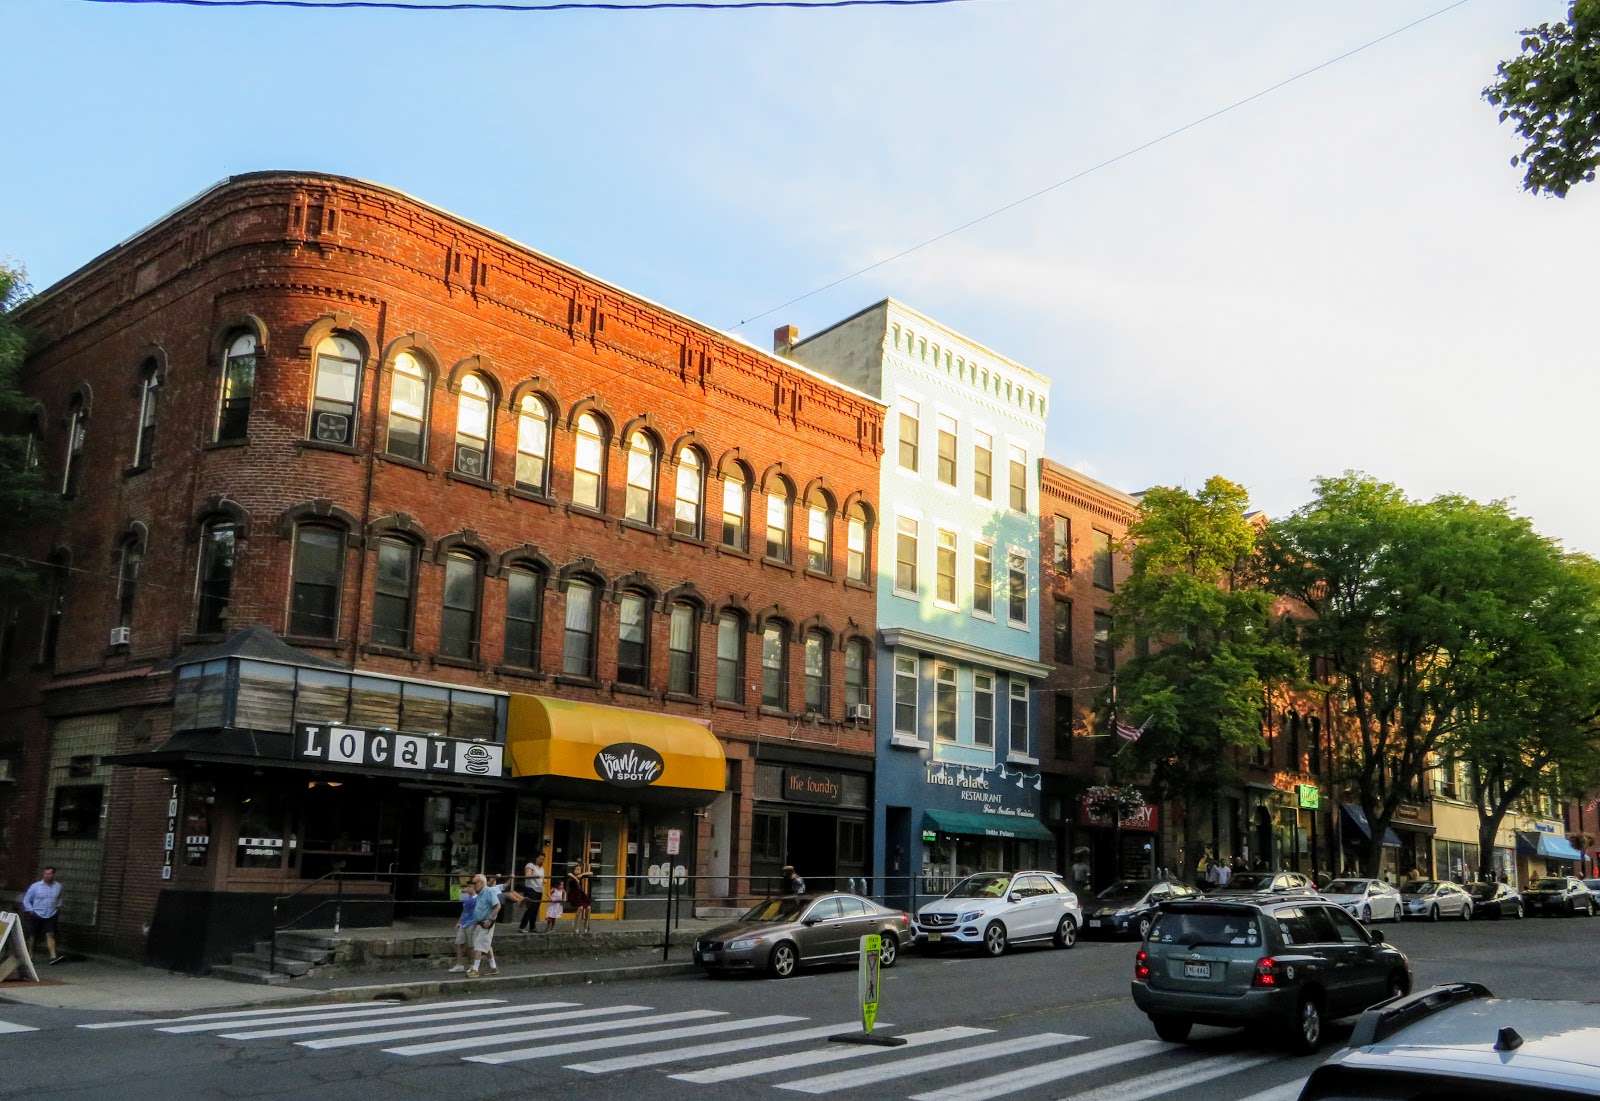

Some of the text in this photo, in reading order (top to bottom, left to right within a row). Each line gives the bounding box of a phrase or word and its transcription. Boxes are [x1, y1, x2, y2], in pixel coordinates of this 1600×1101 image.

[599, 749, 638, 780] banh
[617, 772, 644, 780] SPOT
[926, 769, 989, 789] India Palace
[807, 776, 839, 799] foundry
[961, 790, 1002, 803] RESTAURANT
